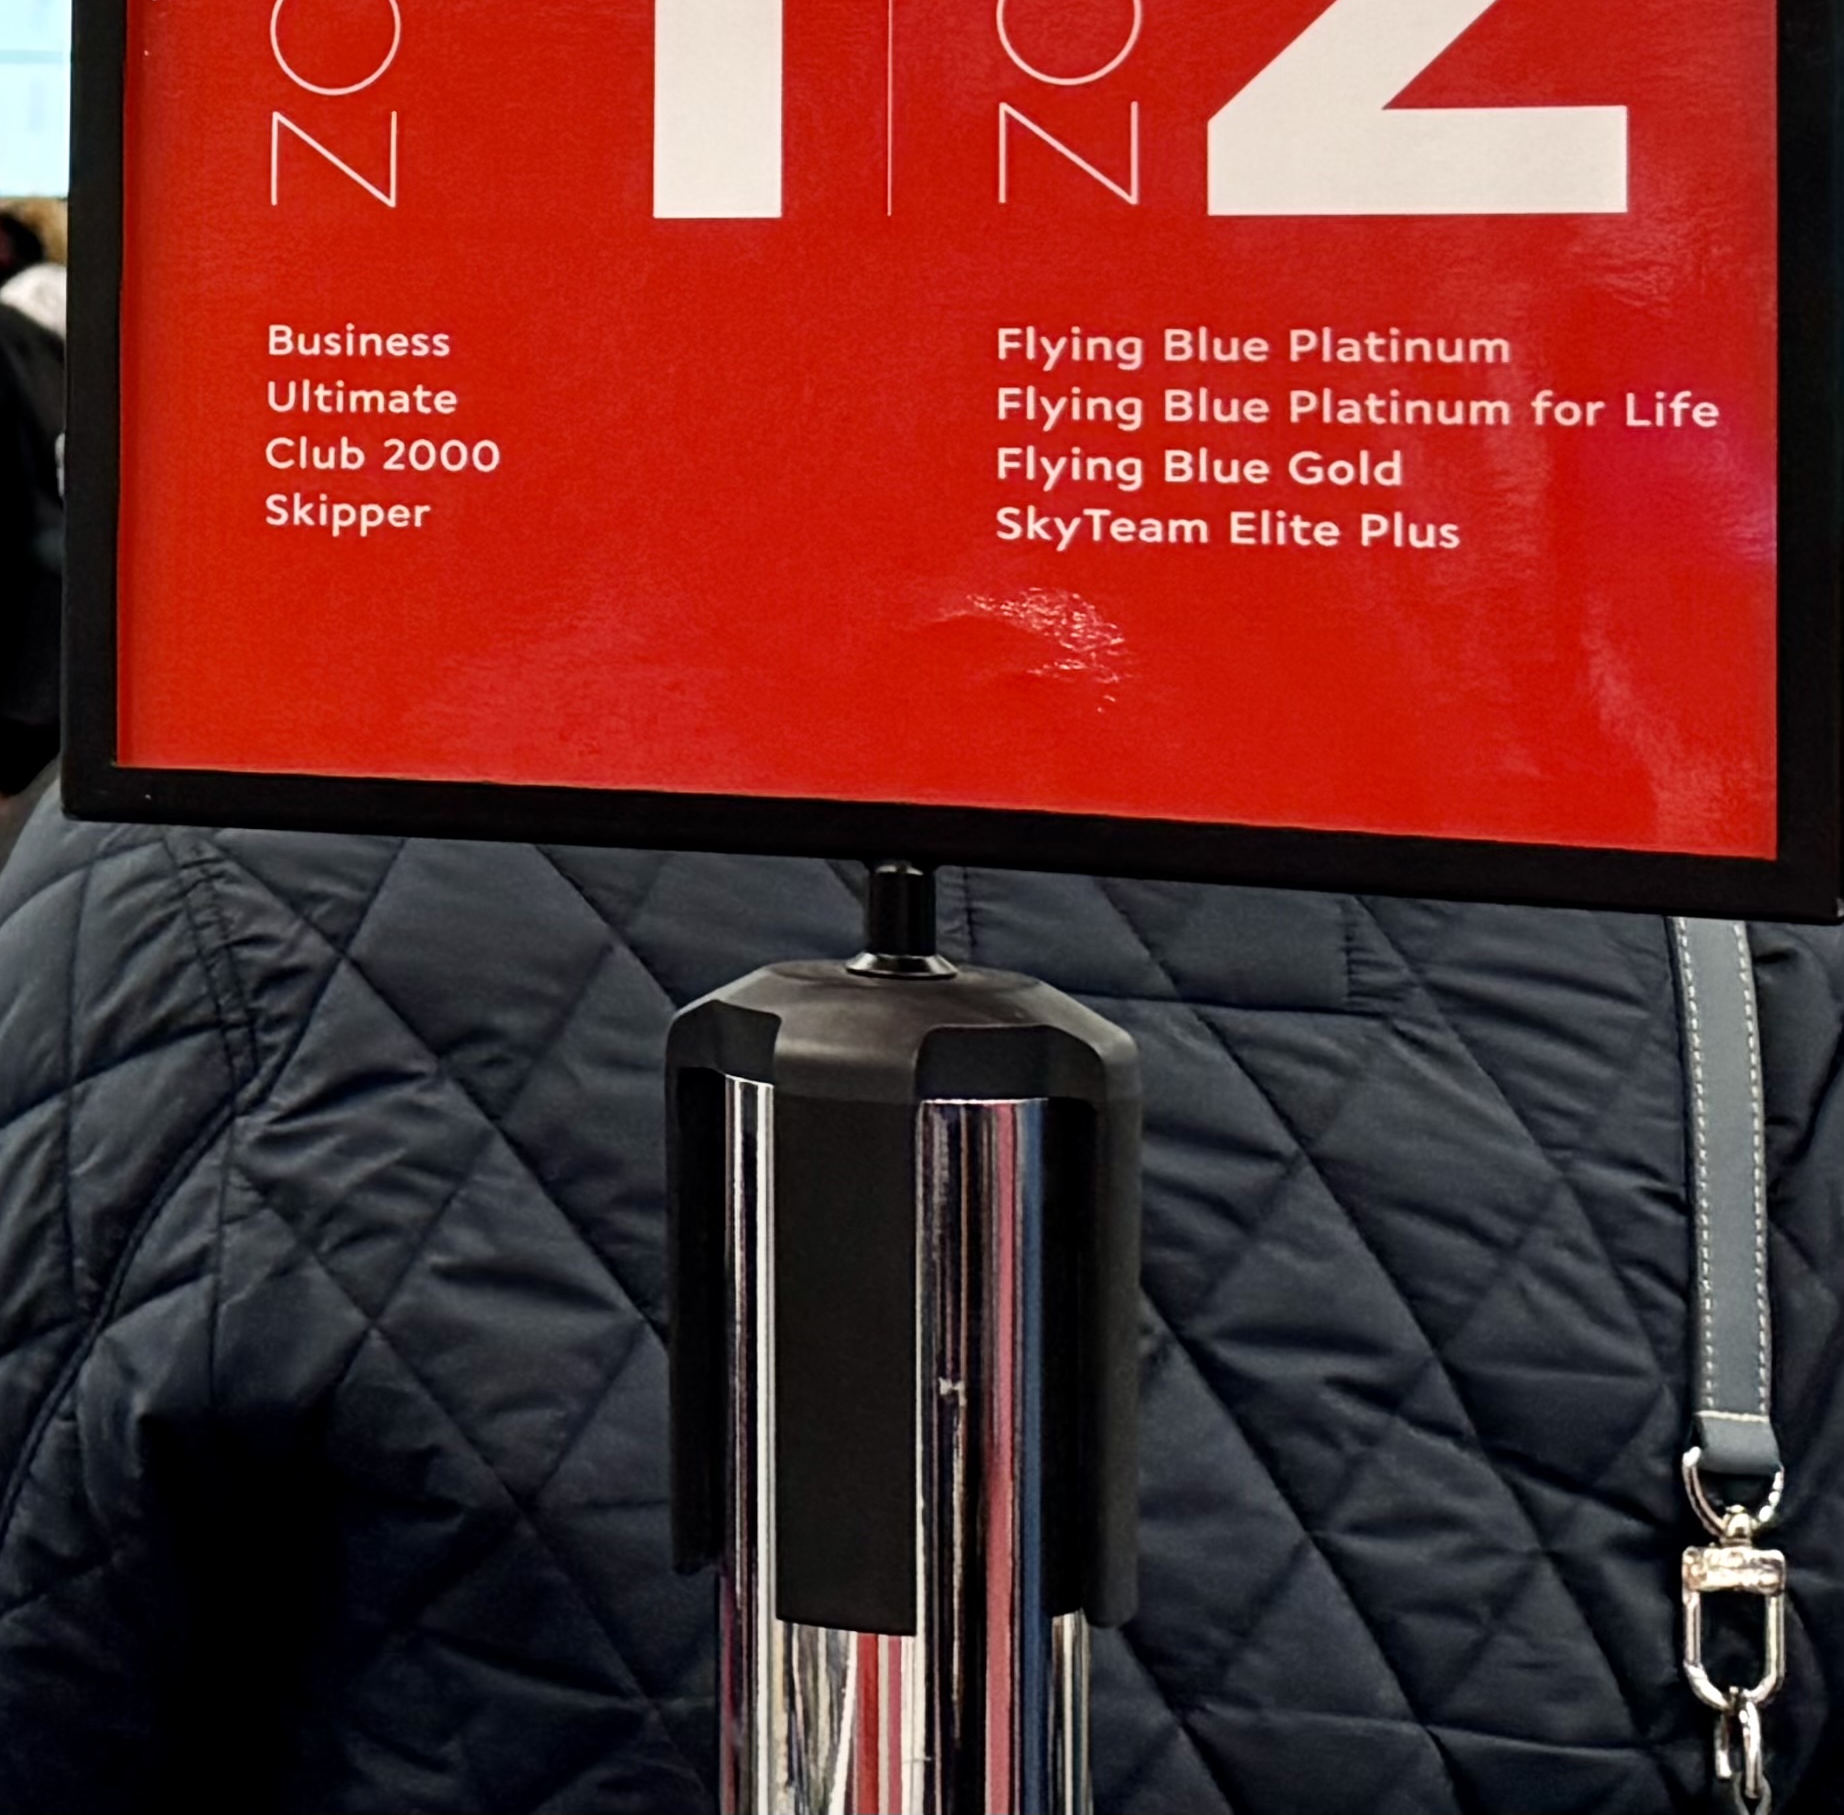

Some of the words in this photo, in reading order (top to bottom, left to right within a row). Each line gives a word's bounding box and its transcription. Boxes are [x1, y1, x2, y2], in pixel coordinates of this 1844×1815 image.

[270, 324, 449, 356] Business
[999, 327, 1141, 370] Flying
[1166, 327, 1268, 361] Blue
[1291, 327, 1509, 362] Platinum
[269, 380, 457, 413] Ultimate
[999, 386, 1141, 431] Flying
[1166, 388, 1268, 422] Blue
[1291, 389, 1509, 424] Platinum
[1532, 390, 1604, 425] for
[1627, 391, 1719, 427] Life
[266, 437, 364, 469] Club
[384, 439, 499, 472] 2000
[999, 446, 1142, 491] Flying
[1166, 448, 1269, 483] Blue
[1289, 451, 1401, 485] Gold
[267, 493, 430, 536] Skipper
[997, 506, 1207, 551] SkyTeam
[1231, 510, 1340, 546] Elite
[1362, 512, 1459, 548] Plus
